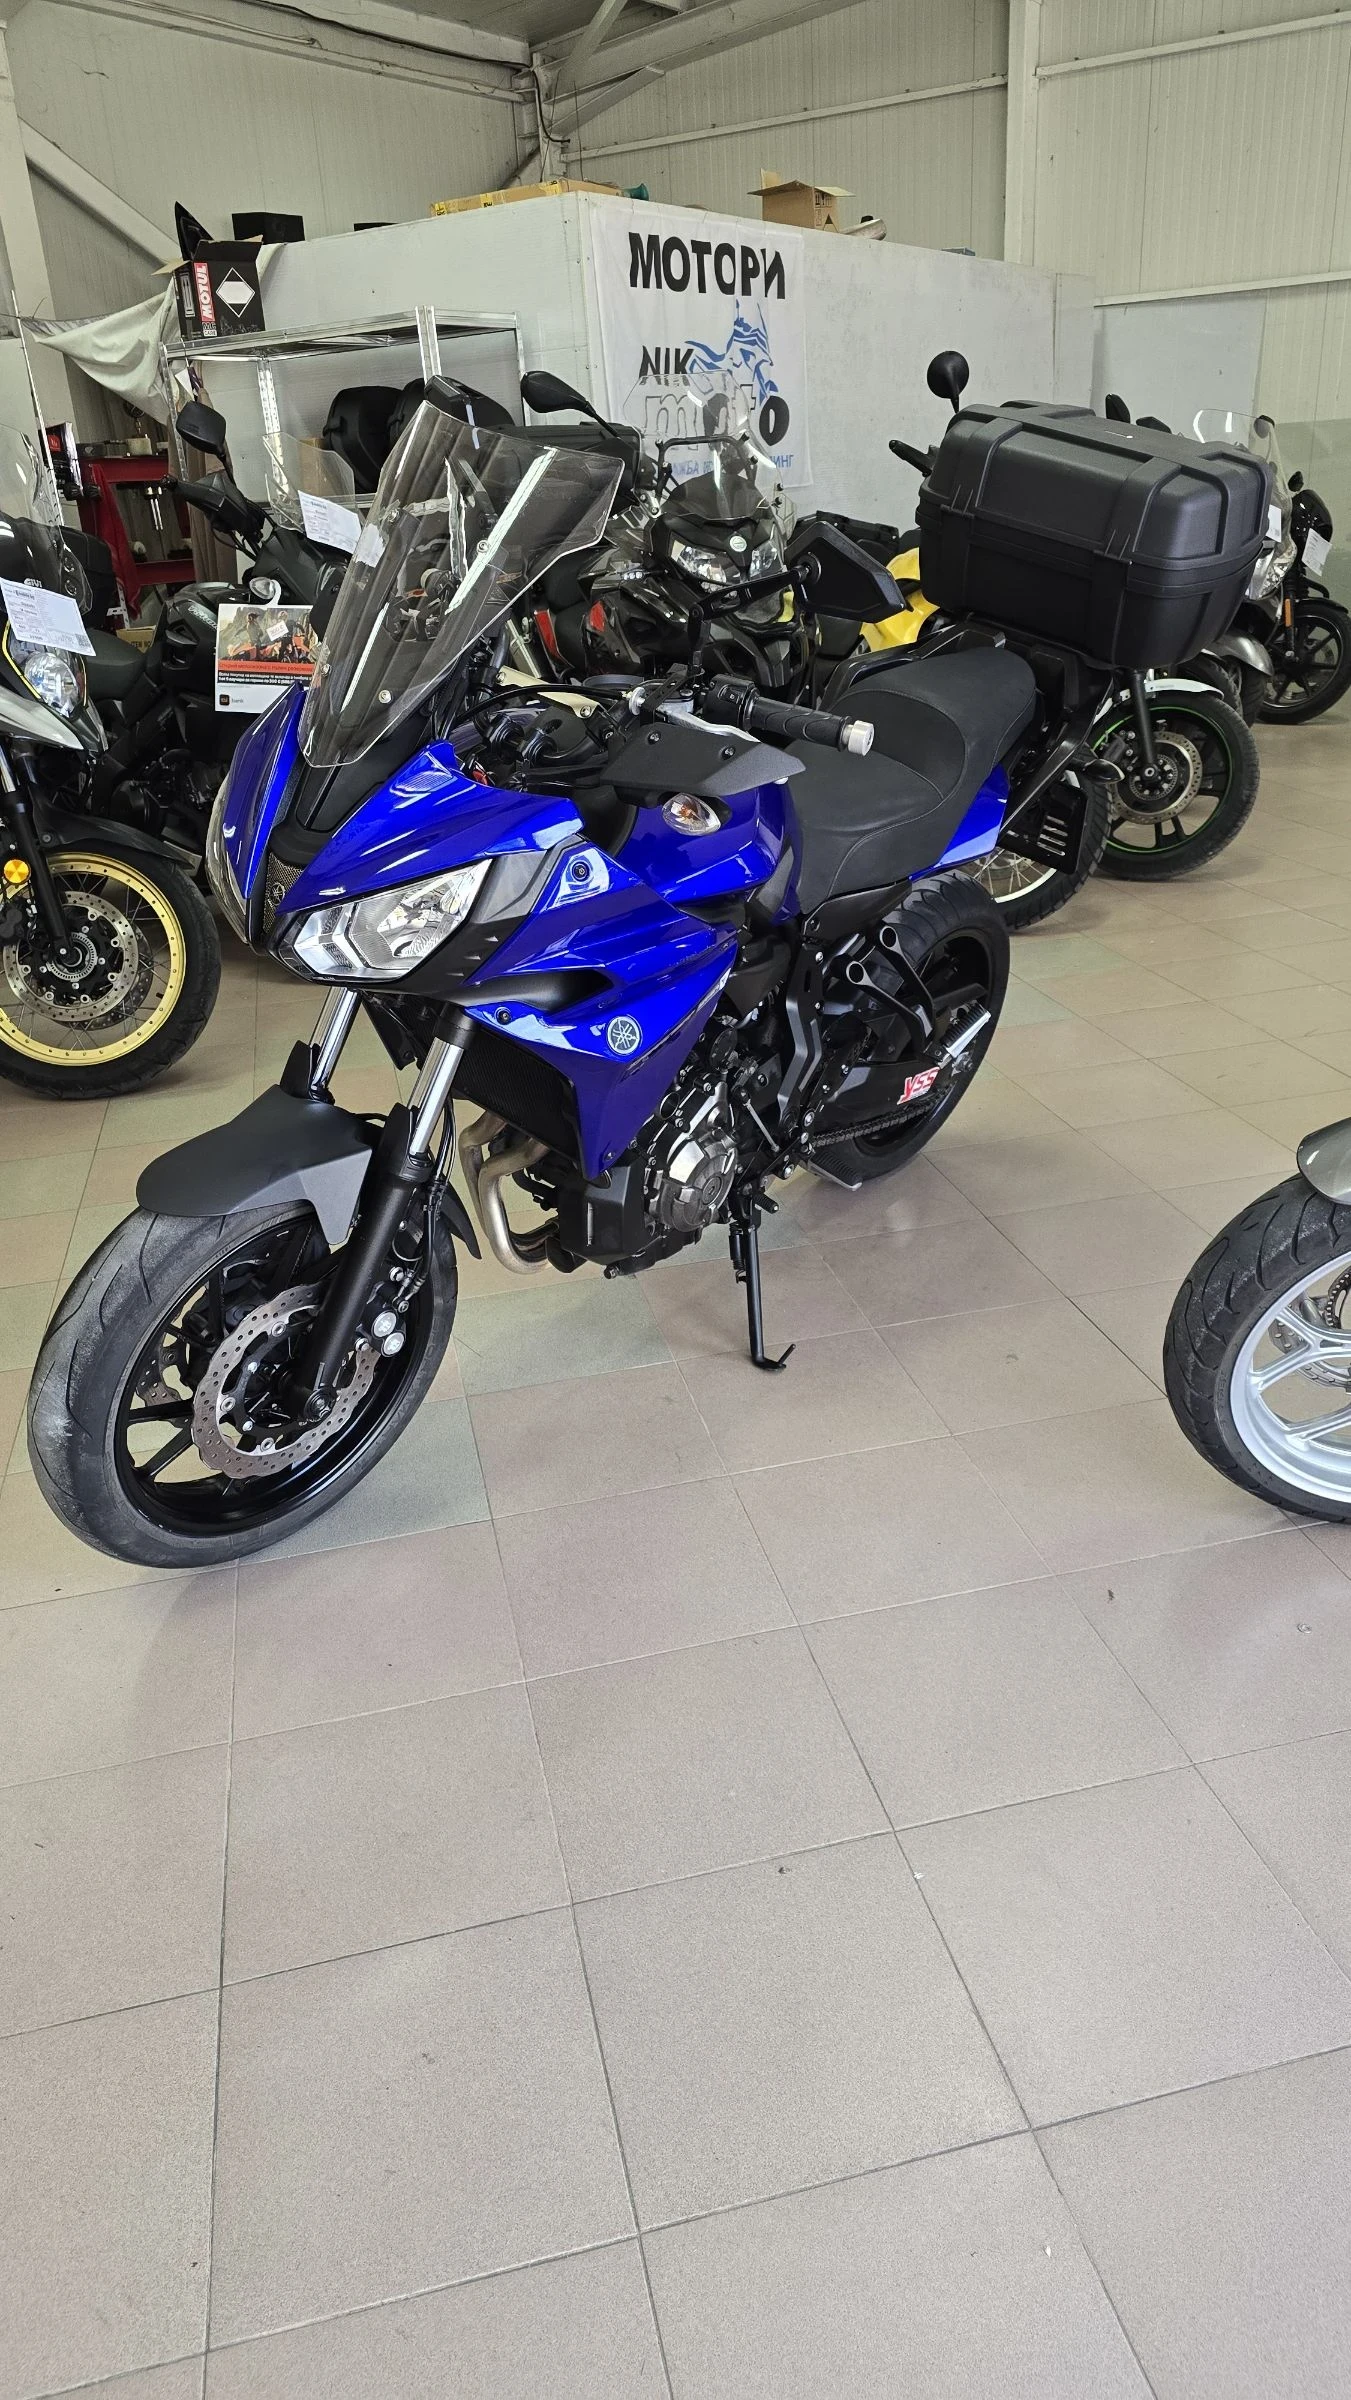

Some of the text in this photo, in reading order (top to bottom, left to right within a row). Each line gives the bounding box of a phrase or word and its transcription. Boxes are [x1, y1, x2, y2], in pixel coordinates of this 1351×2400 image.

[195, 264, 214, 317] MOTUL
[628, 232, 786, 300] МОТОРИ
[638, 345, 695, 387] NIK
